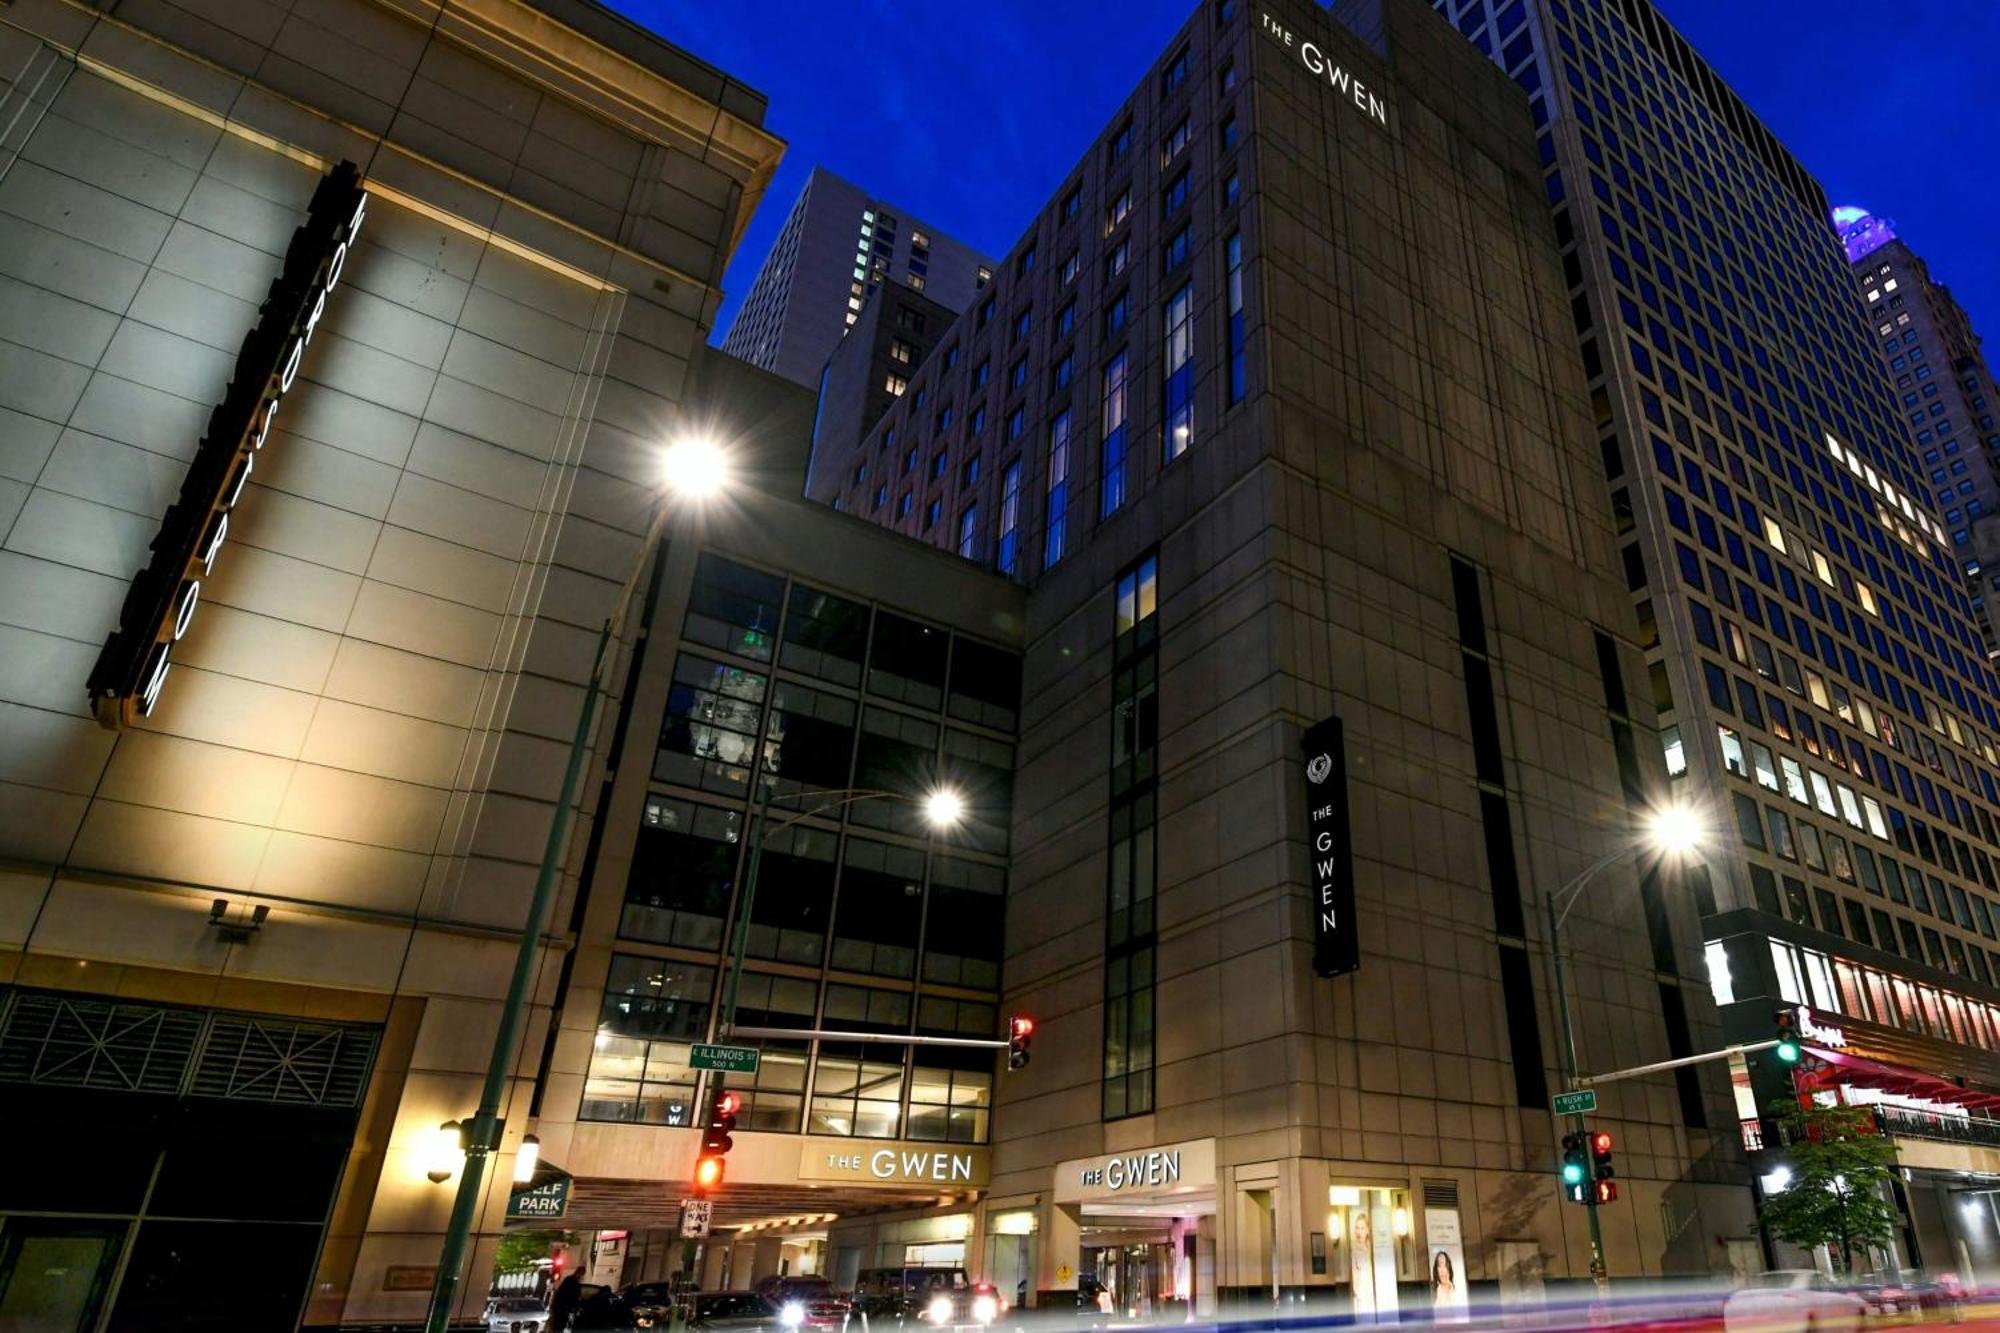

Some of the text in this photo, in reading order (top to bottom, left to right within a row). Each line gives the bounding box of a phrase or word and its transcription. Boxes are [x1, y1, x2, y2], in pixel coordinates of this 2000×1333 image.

[1263, 13, 1385, 125] THE GWEN
[143, 191, 367, 718] NORDSTROM
[1312, 804, 1333, 822] THE
[1316, 831, 1337, 933] GWEN
[700, 1047, 745, 1061] ILLINOIS
[746, 1053, 756, 1061] ST
[728, 1061, 736, 1069] N
[1562, 1094, 1582, 1105] RUSH
[826, 1149, 972, 1181] THE GWEN
[1081, 1149, 1180, 1190] THE GWEN
[532, 1182, 563, 1195] ELF
[519, 1197, 562, 1210] PARK
[689, 1202, 709, 1211] ONE
[687, 1211, 709, 1223] WAY
